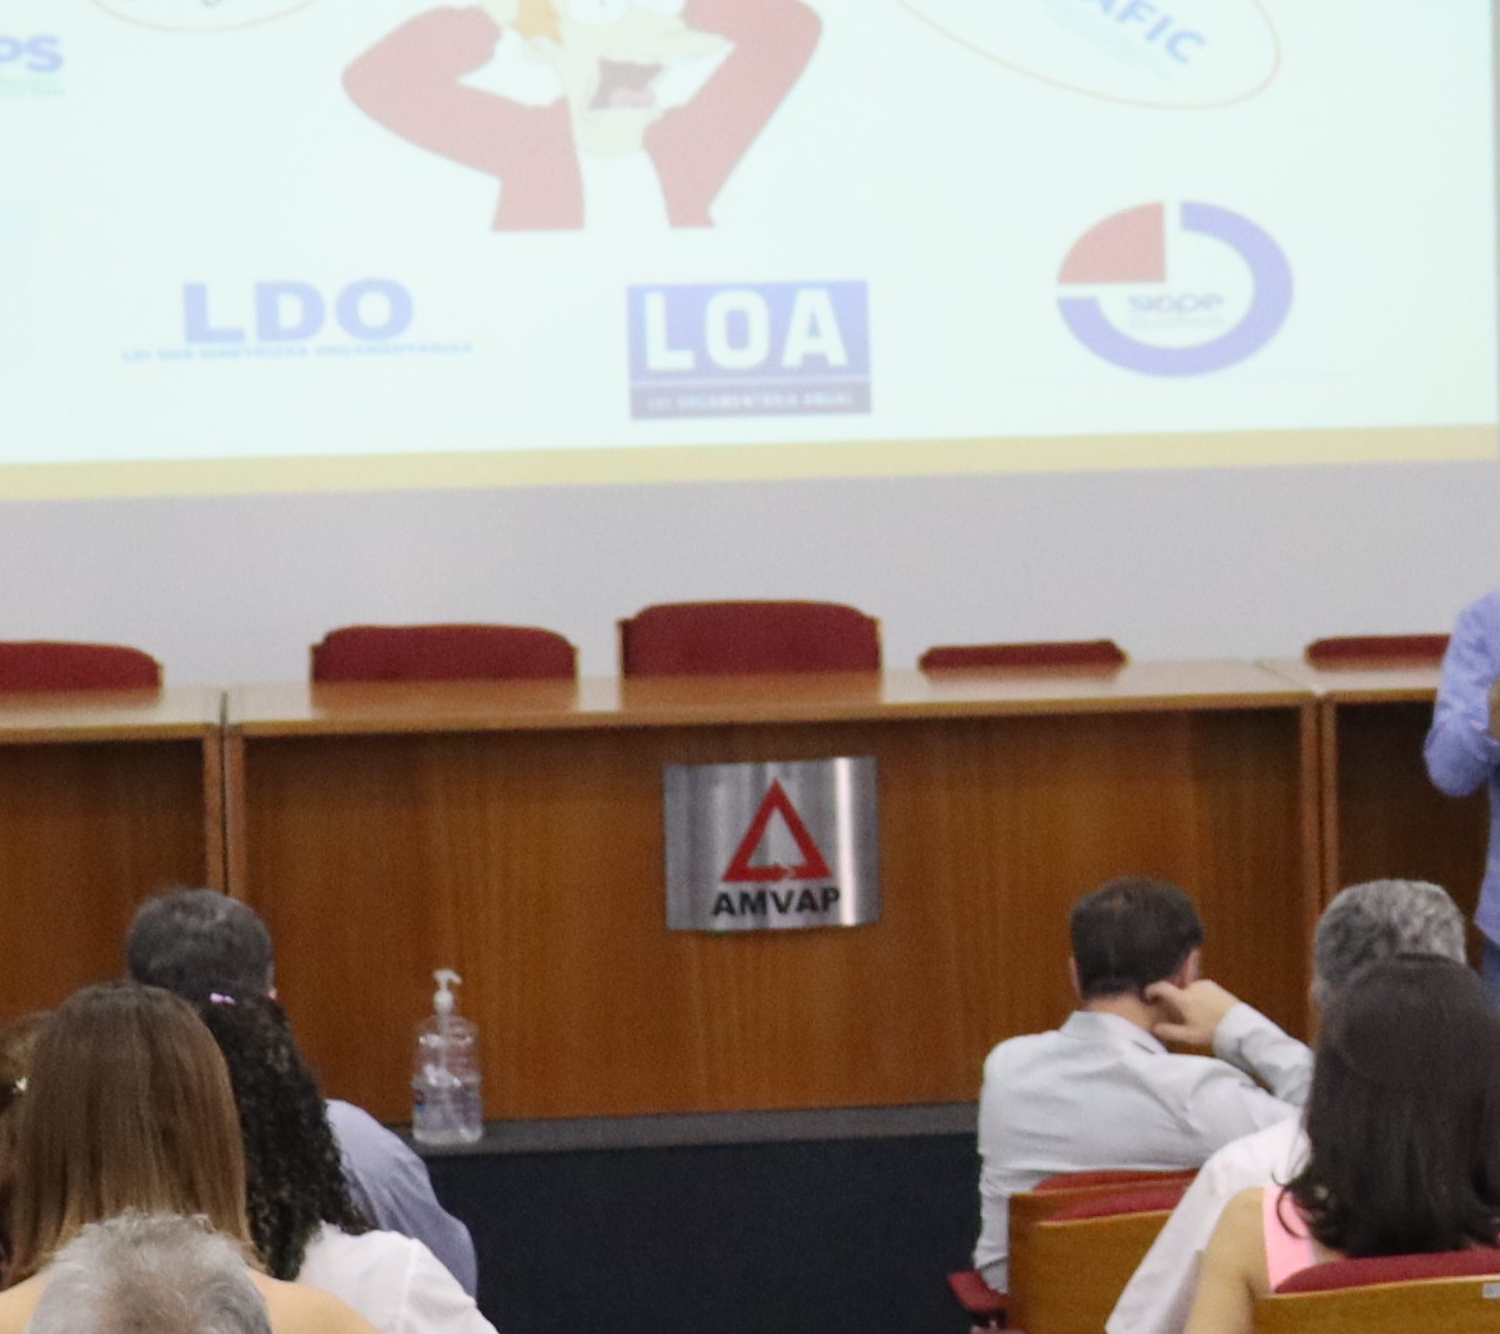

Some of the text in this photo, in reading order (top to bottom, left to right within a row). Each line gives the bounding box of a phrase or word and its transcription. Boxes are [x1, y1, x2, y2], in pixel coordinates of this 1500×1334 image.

[182, 276, 413, 343] LDO
[645, 288, 848, 371] LOA
[712, 886, 842, 920] AMVAP
